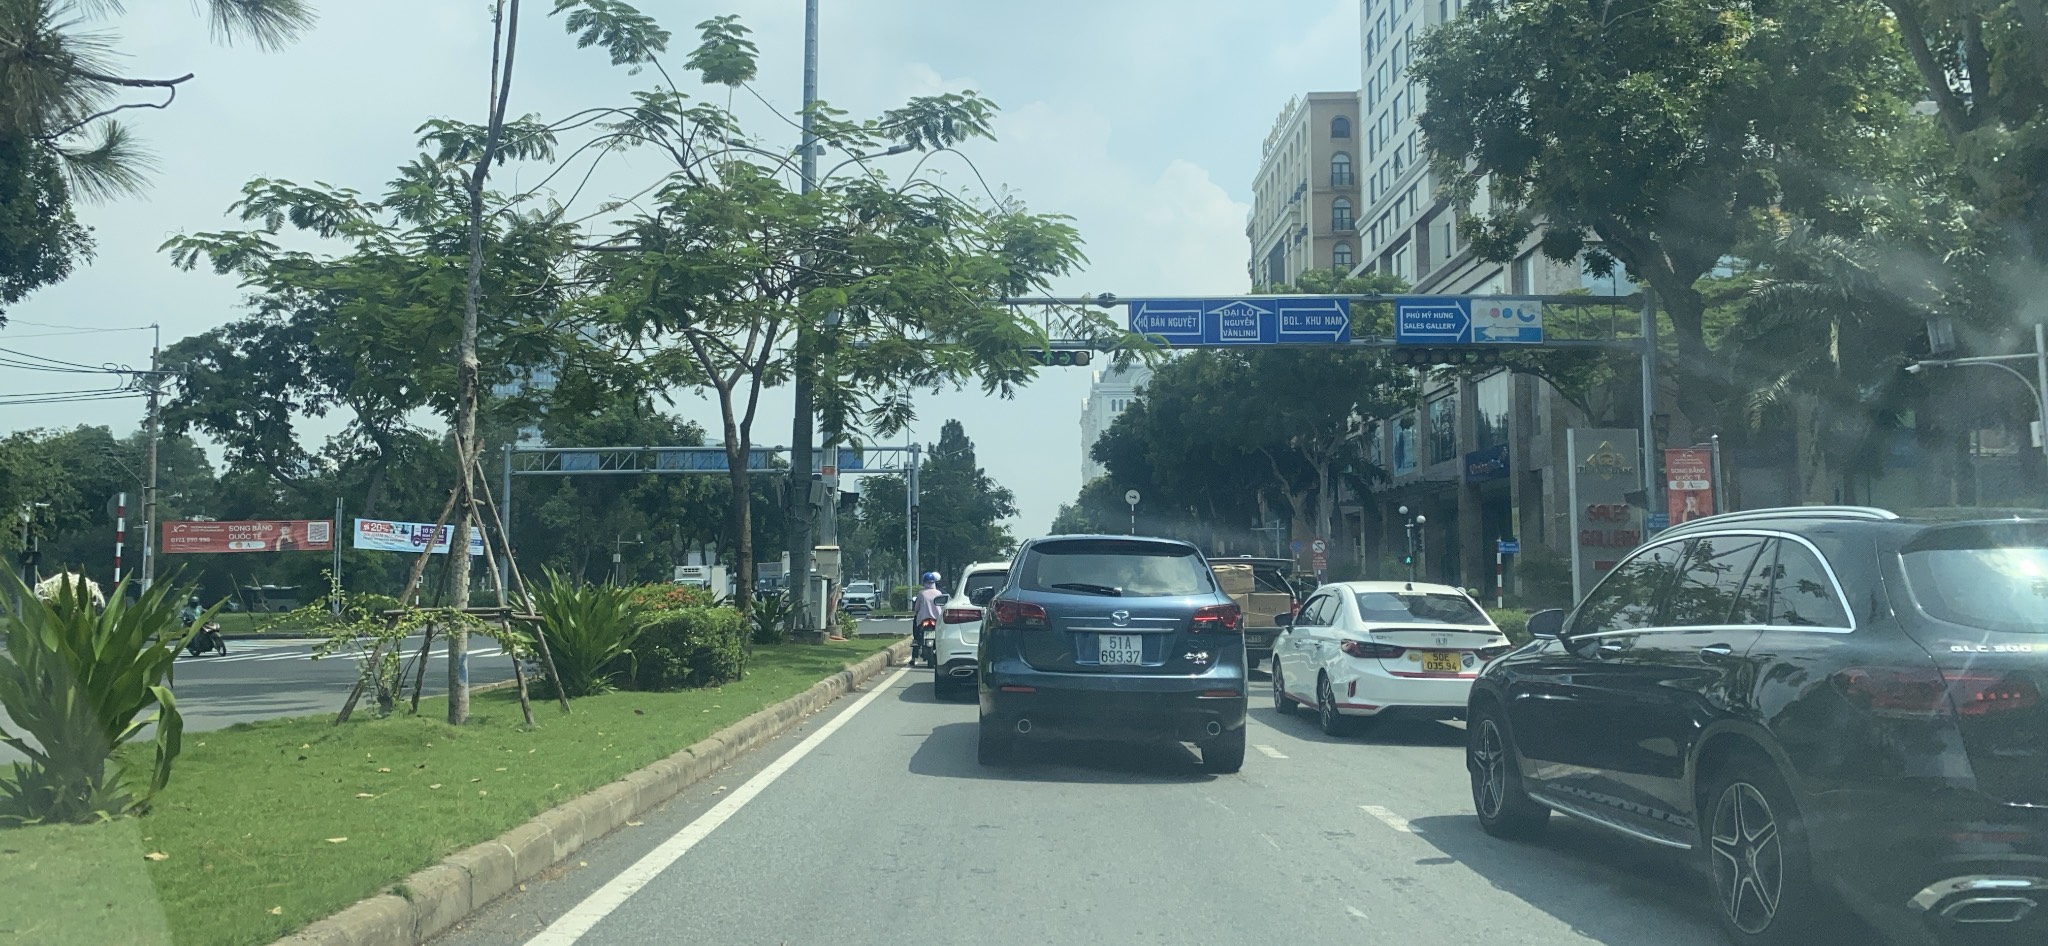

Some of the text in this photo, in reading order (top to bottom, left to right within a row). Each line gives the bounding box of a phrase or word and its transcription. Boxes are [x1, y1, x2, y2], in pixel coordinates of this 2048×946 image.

[1224, 308, 1254, 318] ĐẠI LỘ
[1405, 311, 1420, 319] PHÚ
[1421, 310, 1432, 319] MỸ
[1150, 315, 1165, 327] BÁN
[1168, 315, 1197, 328] NGUYỆT
[1283, 316, 1342, 326] BQL. KHU NAM
[1425, 322, 1456, 330] GALLERY
[252, 523, 273, 531] BẰNG
[228, 531, 262, 540] QUỐC TẾ
[1109, 636, 1132, 650] 51A
[1950, 645, 2032, 653] GLC 300
[1101, 650, 1140, 664] 693.37
[1433, 653, 1450, 662] 50E
[1427, 661, 1457, 671] 035.94
